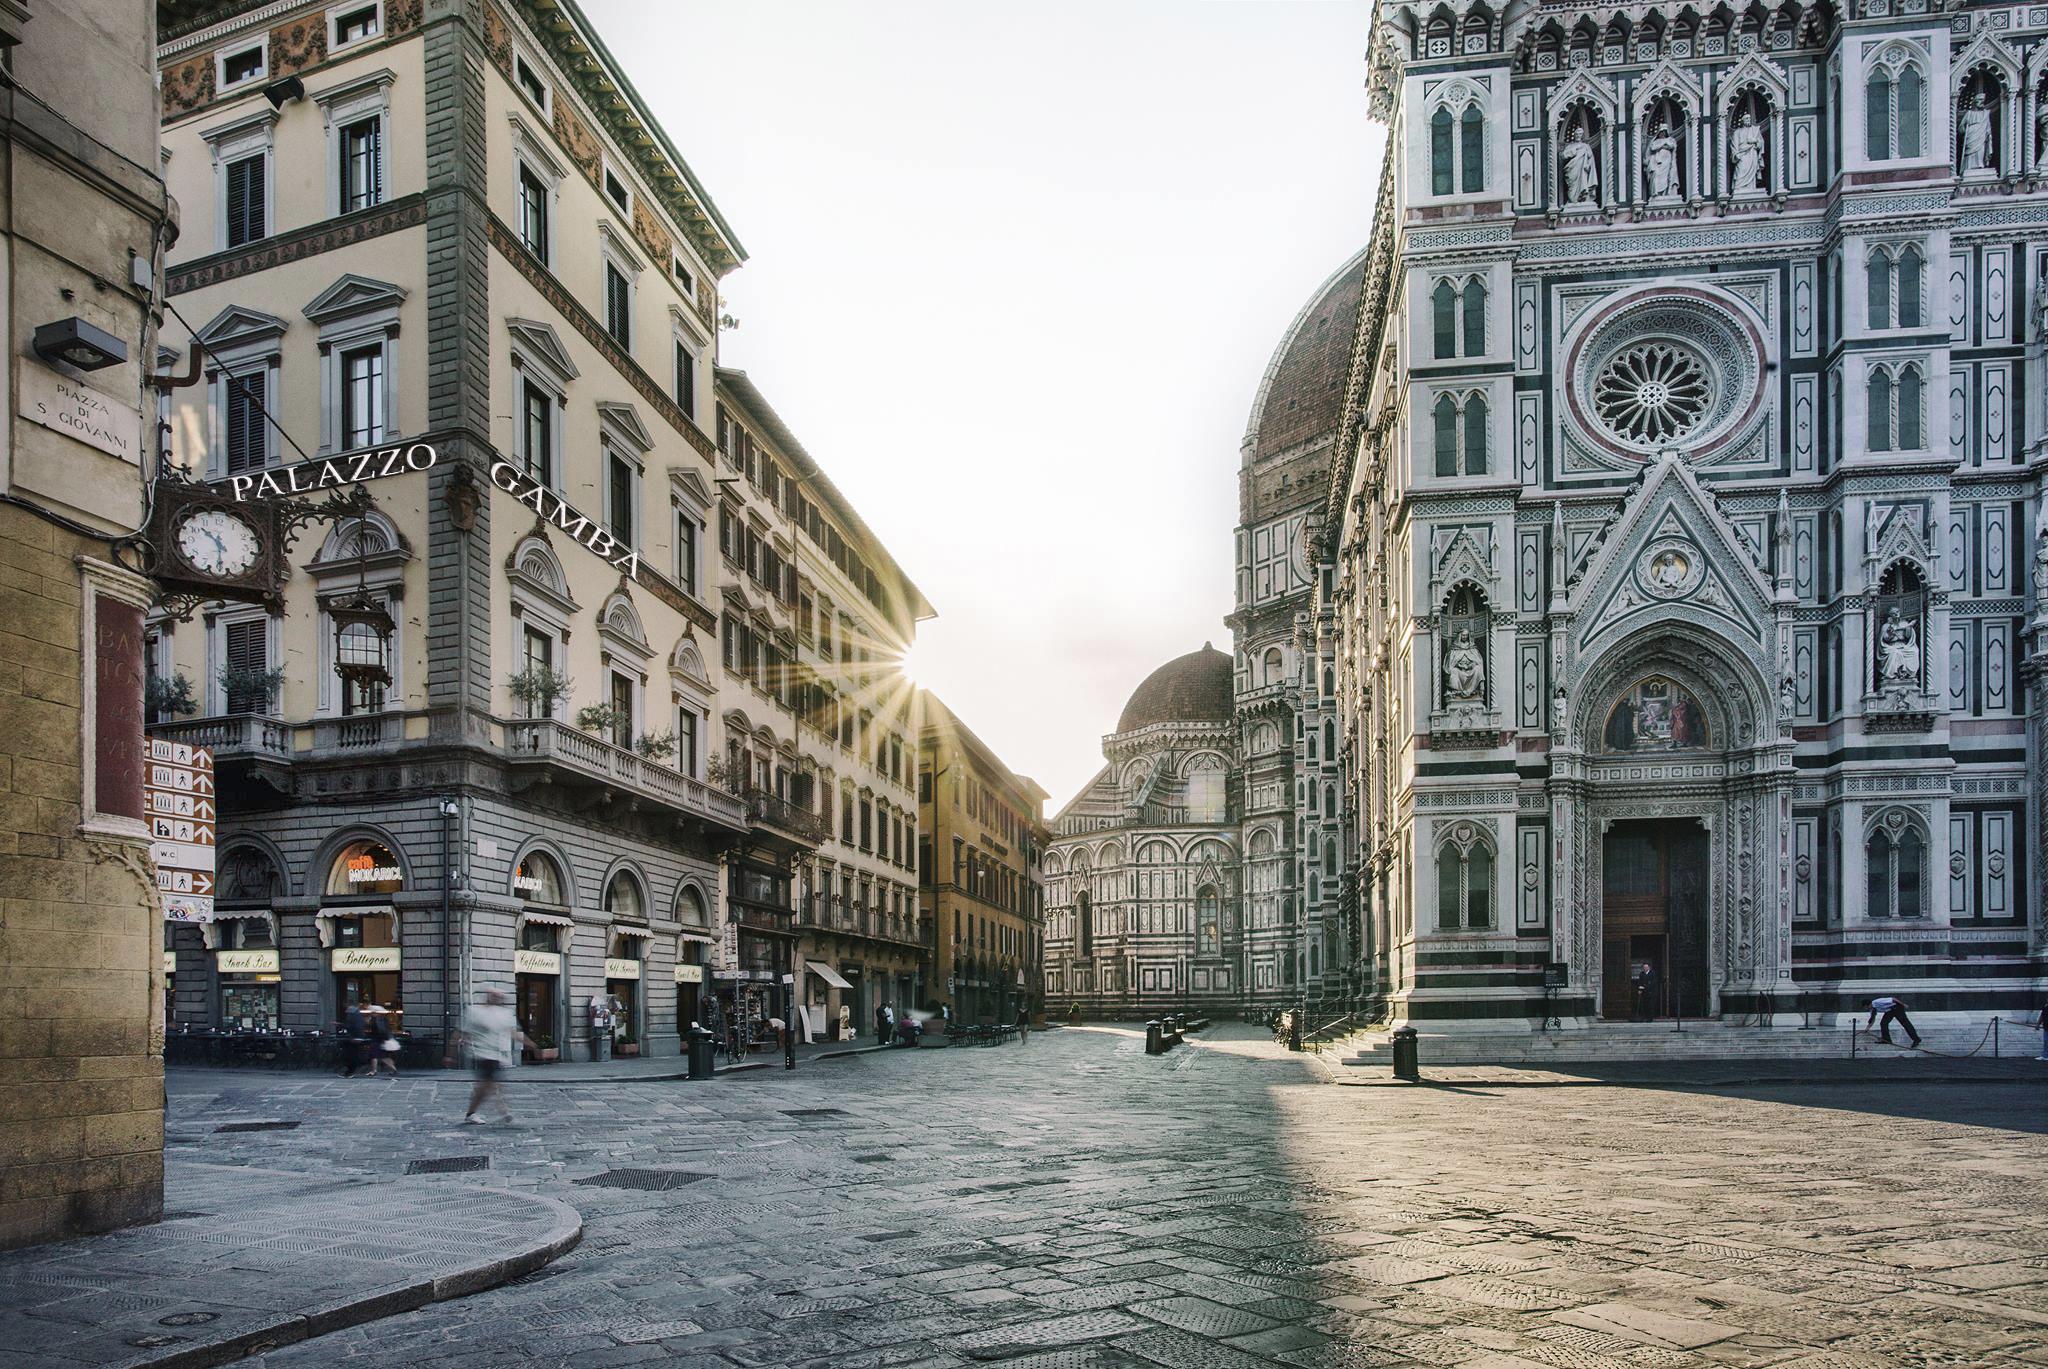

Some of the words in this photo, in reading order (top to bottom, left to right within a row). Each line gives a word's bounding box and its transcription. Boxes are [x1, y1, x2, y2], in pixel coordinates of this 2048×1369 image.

[57, 384, 109, 415] PIAZZA
[78, 407, 89, 419] DI
[59, 412, 127, 449] GIOVANNI
[229, 443, 437, 502] PALAZZO
[490, 462, 639, 583] GAMBA
[224, 954, 252, 969] Snack
[253, 953, 273, 968] Bar
[342, 950, 390, 968] Bottegone
[519, 951, 555, 970] Caffetteria
